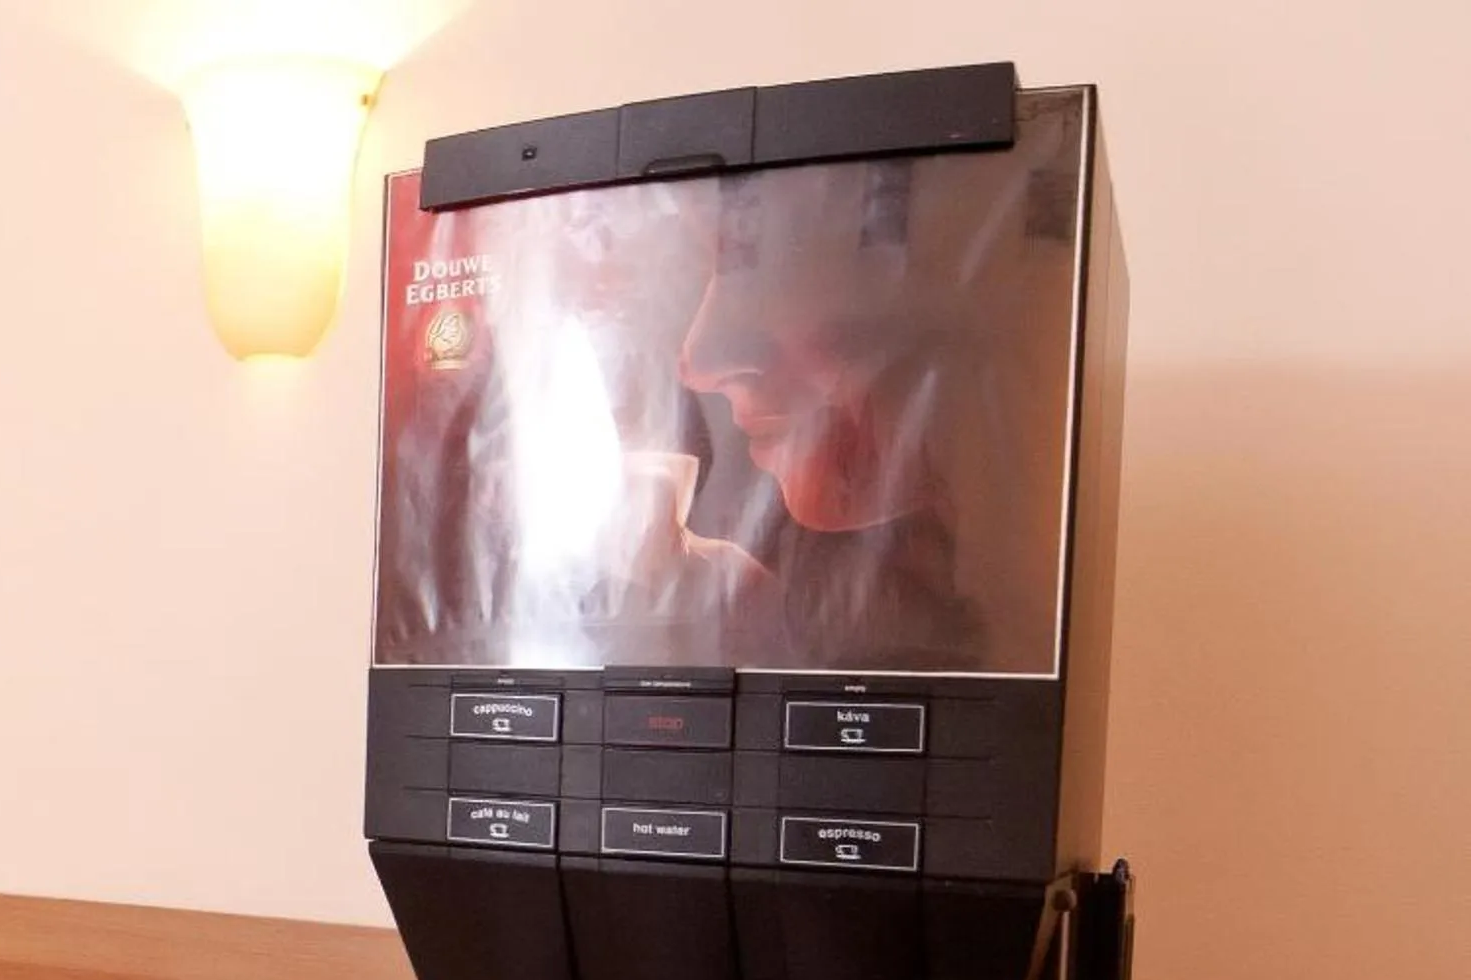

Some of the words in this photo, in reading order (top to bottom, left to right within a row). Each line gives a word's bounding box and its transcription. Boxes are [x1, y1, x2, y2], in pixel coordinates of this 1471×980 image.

[413, 254, 494, 282] DOUWE
[406, 277, 502, 305] EGBERTS
[473, 702, 533, 717] cappuccino
[836, 708, 870, 722] káva
[632, 822, 653, 834] hot
[656, 823, 692, 836] water
[817, 828, 881, 842] espresso
